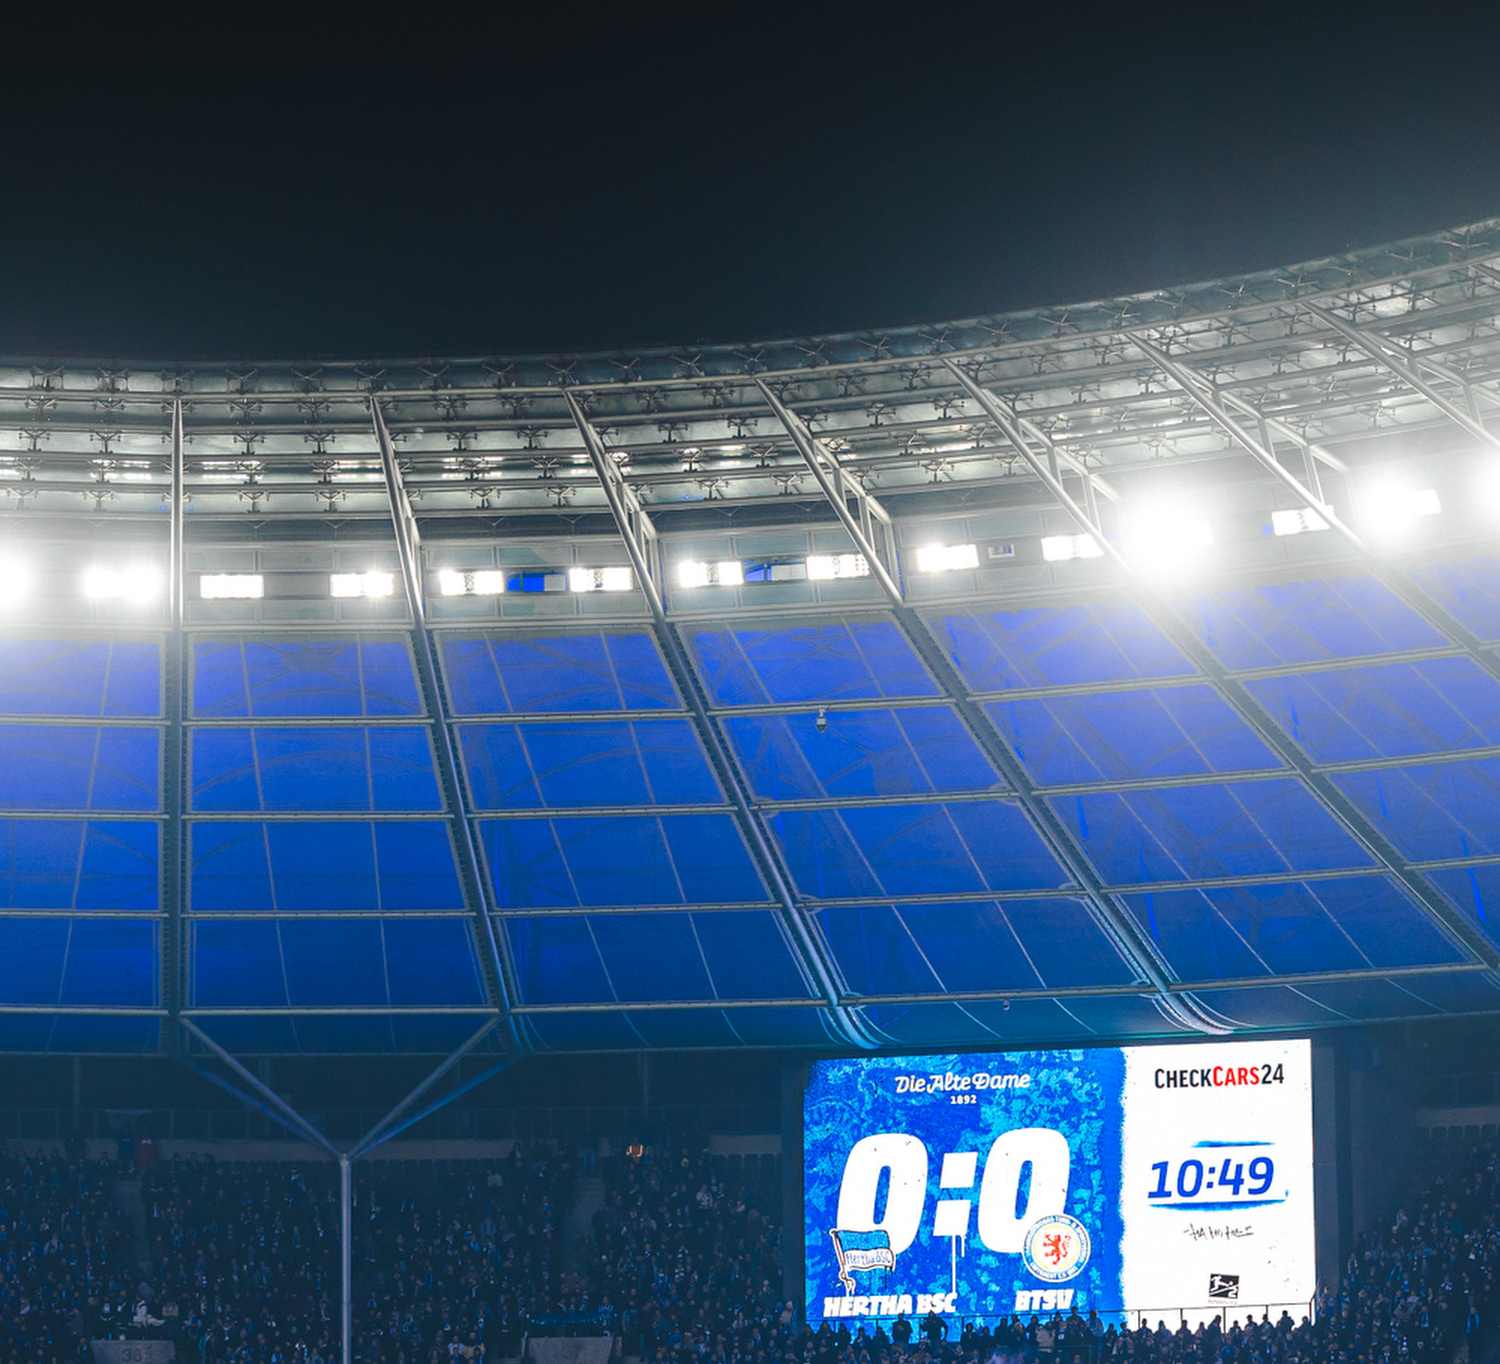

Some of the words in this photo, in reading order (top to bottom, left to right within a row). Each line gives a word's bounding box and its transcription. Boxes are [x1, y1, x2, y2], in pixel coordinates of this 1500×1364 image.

[895, 1075, 926, 1093] Die
[927, 1072, 971, 1093] Alte
[972, 1073, 1031, 1091] Dame
[1154, 1063, 1285, 1089] CHECKCARS24
[950, 1094, 977, 1104] 1892
[1147, 1155, 1275, 1199] 10:49
[837, 1127, 1070, 1255] 0:0
[823, 1295, 913, 1317] HERTHA
[916, 1292, 958, 1314] BSC
[1015, 1288, 1075, 1311] BTSV
